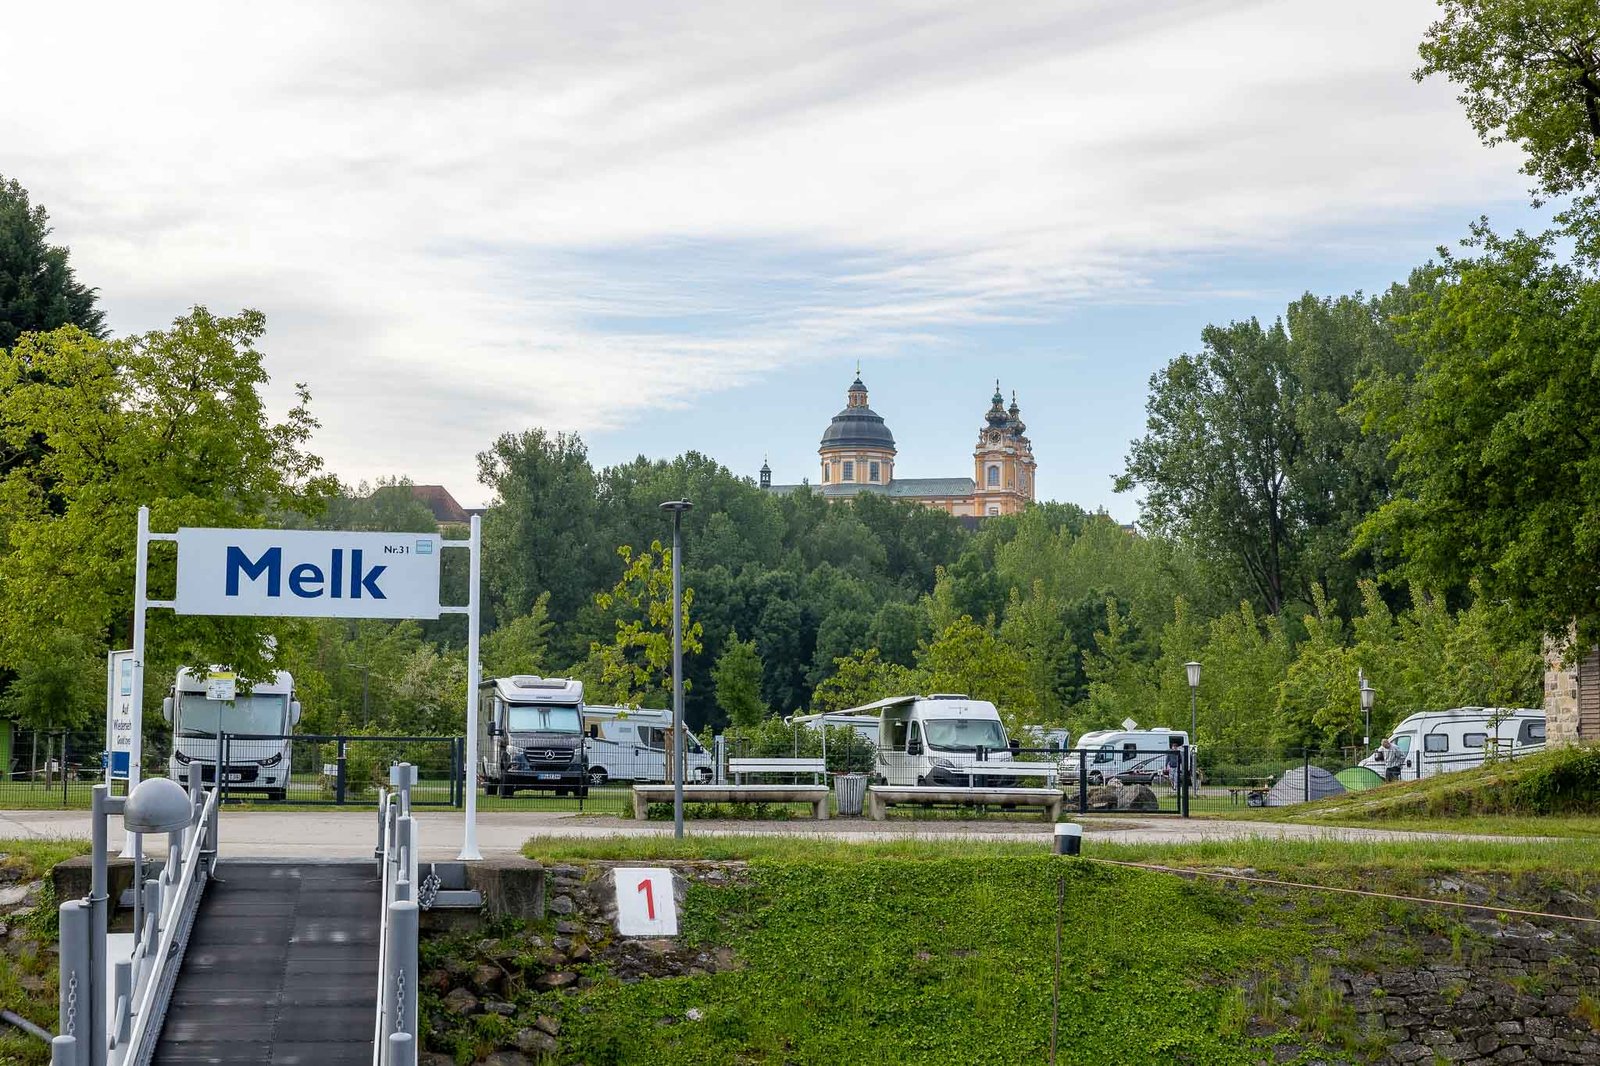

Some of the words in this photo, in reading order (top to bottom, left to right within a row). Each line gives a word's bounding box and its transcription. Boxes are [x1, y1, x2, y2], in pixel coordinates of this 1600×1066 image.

[384, 545, 409, 554] Nr.31
[225, 546, 388, 600] Melk
[637, 879, 655, 920] 1
